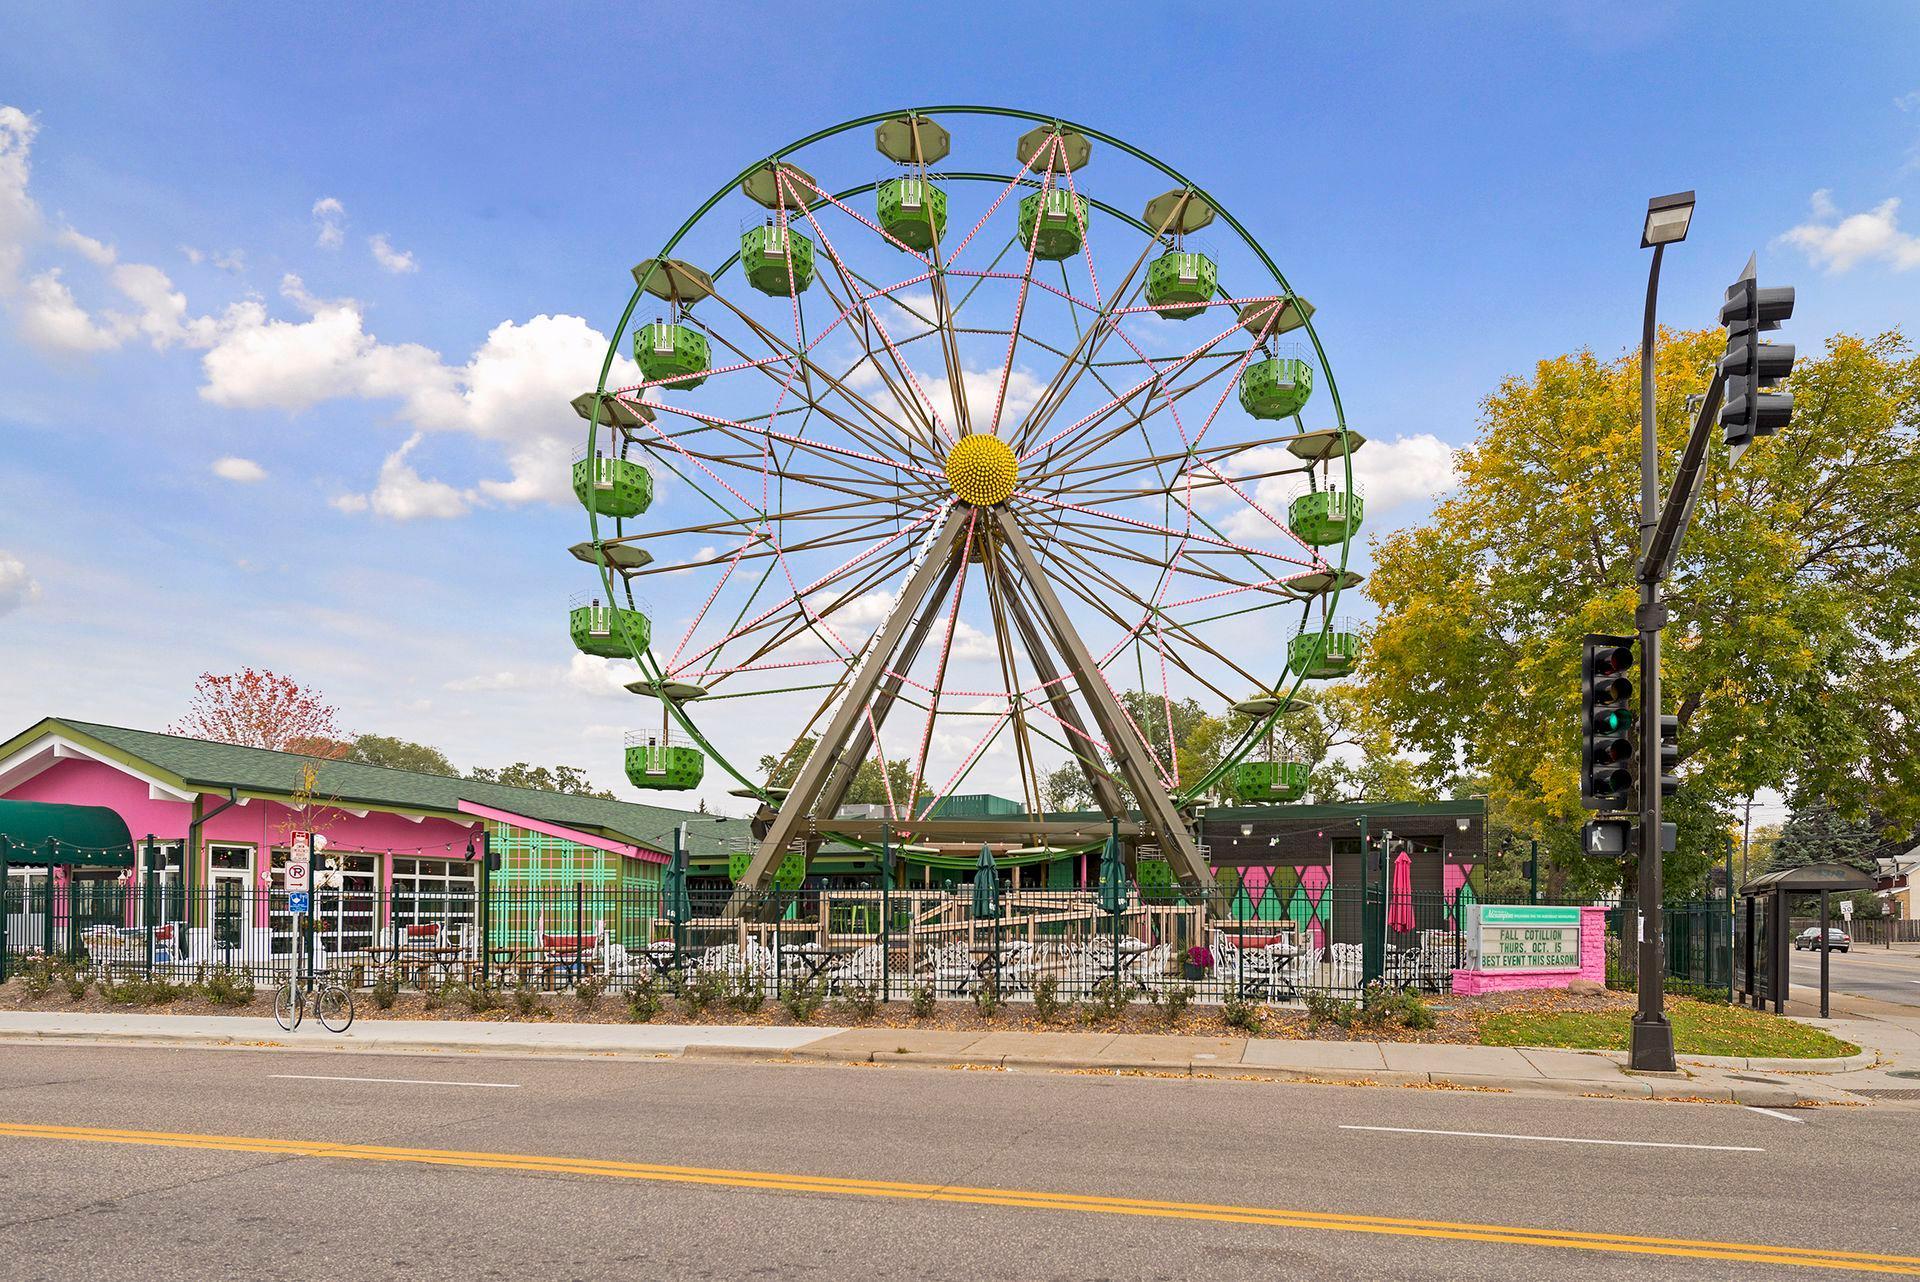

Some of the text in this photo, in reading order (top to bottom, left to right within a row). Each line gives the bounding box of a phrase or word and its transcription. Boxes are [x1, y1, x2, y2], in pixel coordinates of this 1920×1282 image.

[1500, 930, 1562, 940] FALL COTILLION
[1500, 942, 1562, 953] THURS. OCT. 15
[1482, 954, 1577, 967] BEST EVENT THIS SEASON!
